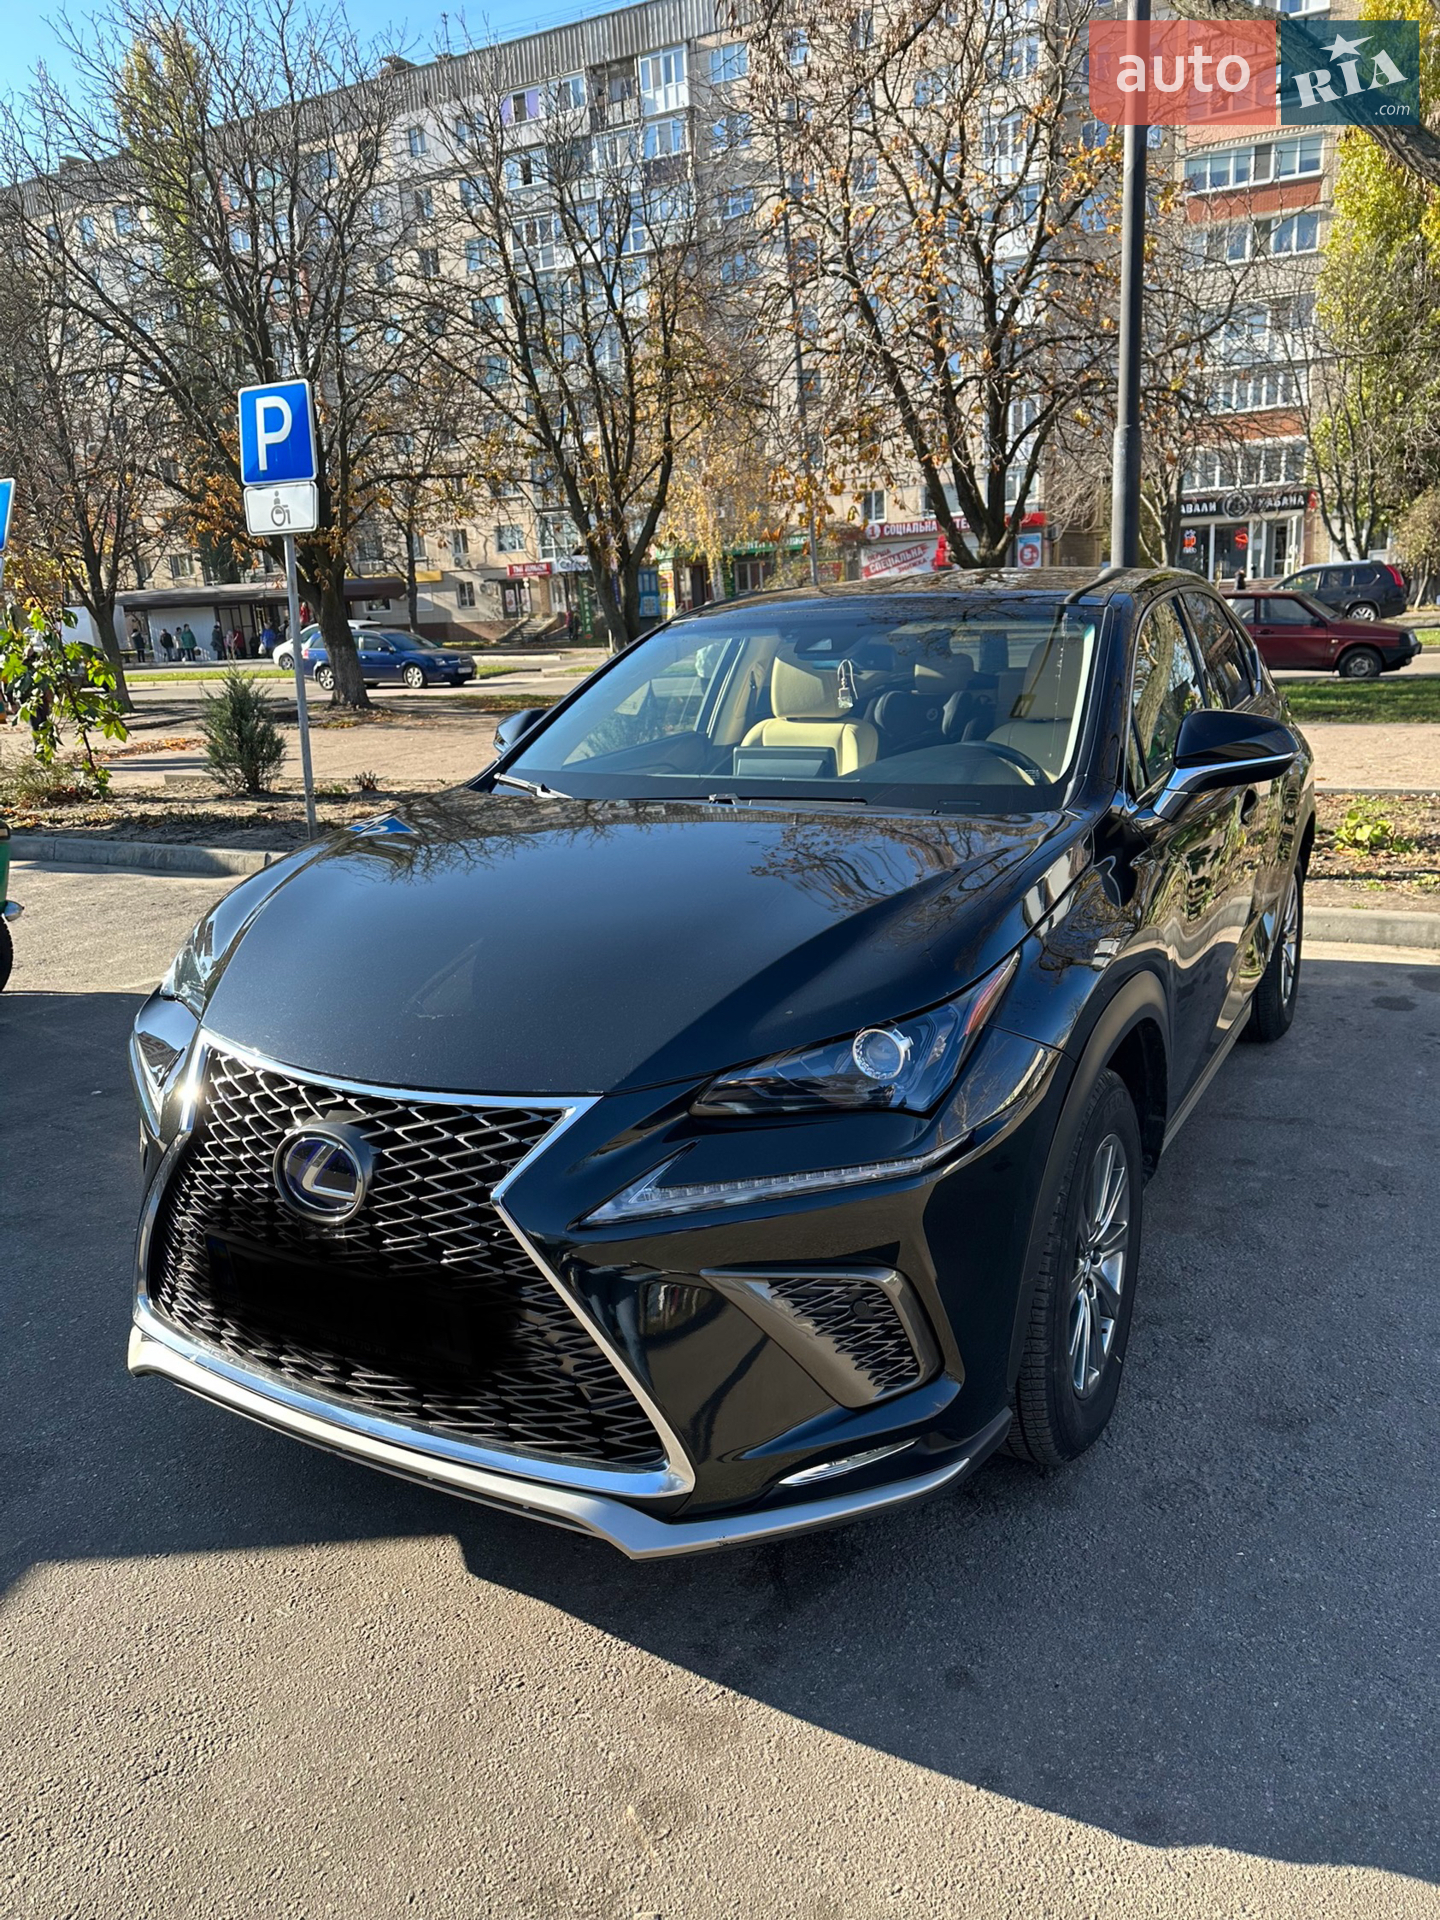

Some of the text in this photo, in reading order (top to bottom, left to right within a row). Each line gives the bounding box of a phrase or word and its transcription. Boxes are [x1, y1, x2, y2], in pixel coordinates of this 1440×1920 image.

[255, 395, 293, 471] P
[1180, 502, 1217, 514] АВАЛИ
[883, 521, 937, 536] СОЦІАЛЬНА
[869, 547, 923, 573] СПЕЦІАЛЬНА
